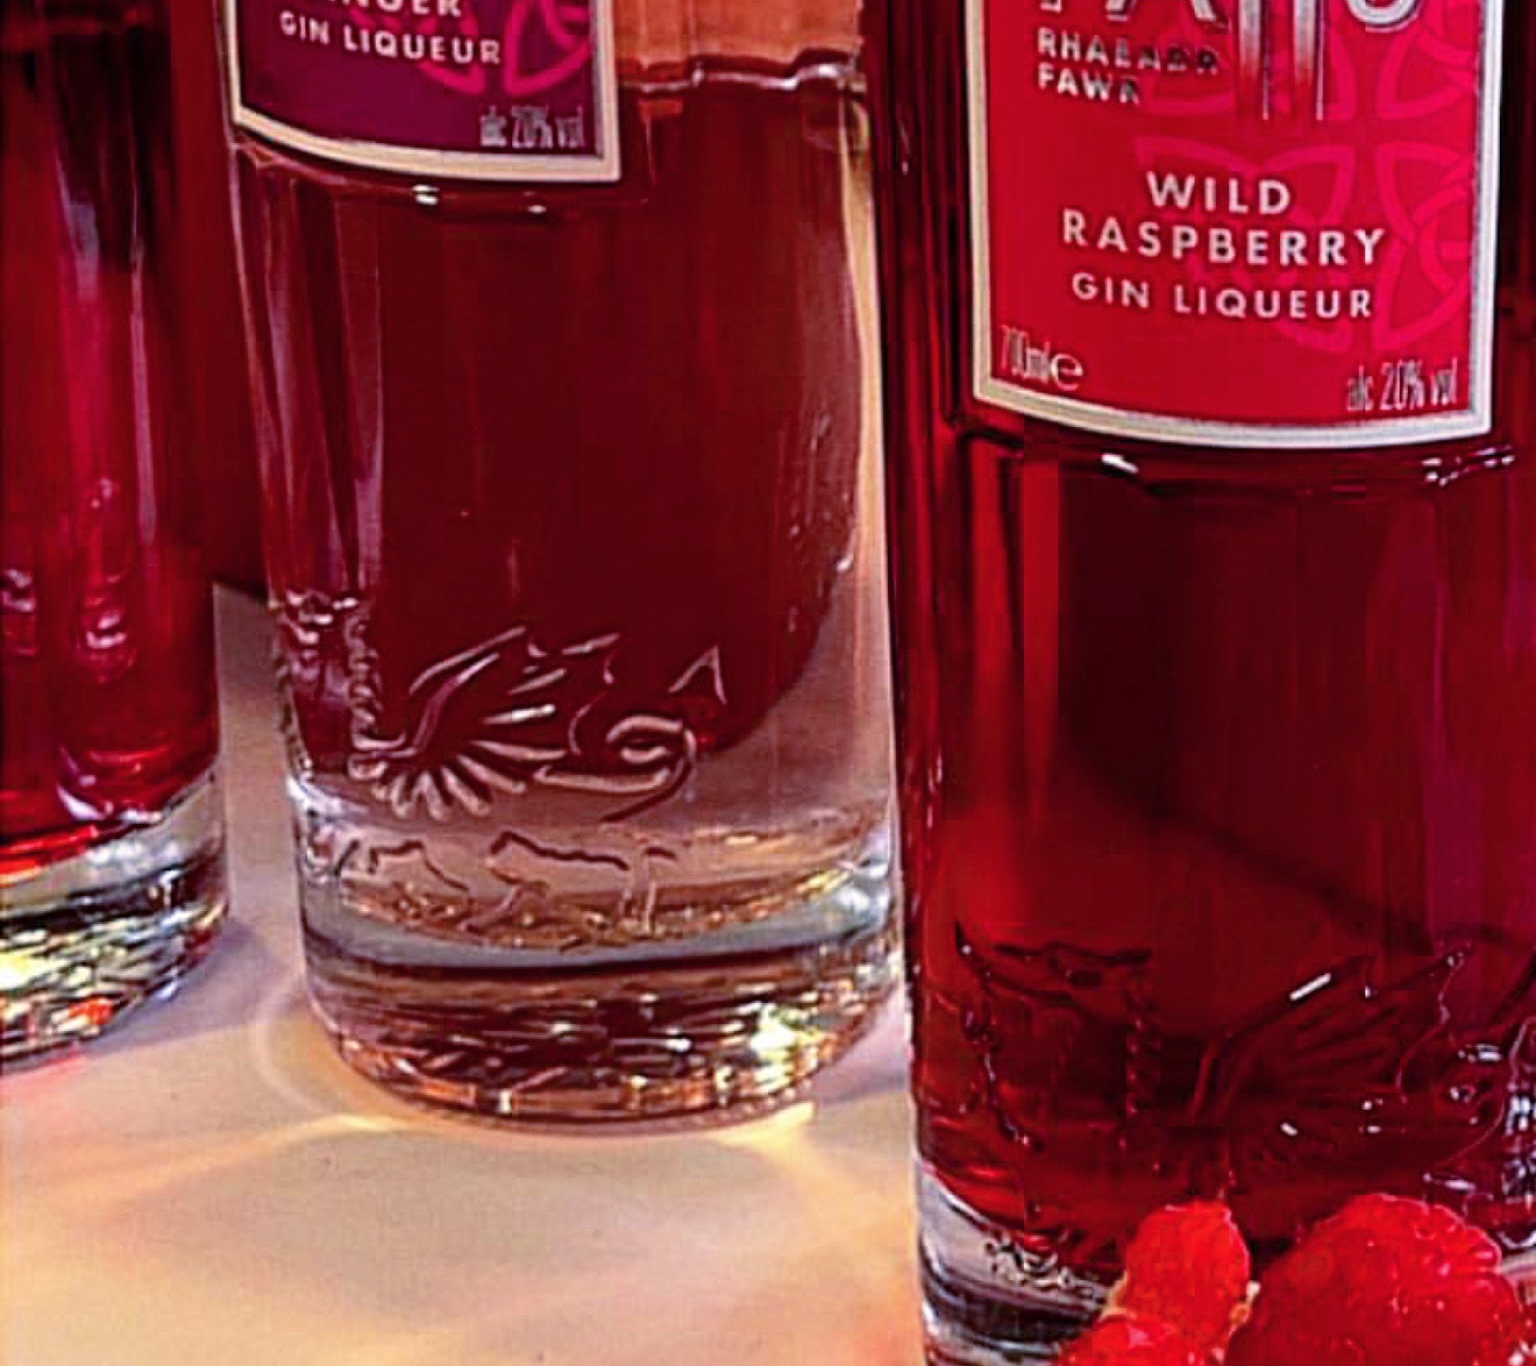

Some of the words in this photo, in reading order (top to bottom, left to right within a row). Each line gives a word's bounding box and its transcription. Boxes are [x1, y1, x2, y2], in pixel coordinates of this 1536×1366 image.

[279, 10, 330, 44] GIN
[343, 25, 501, 65] LIQUEUR
[1146, 171, 1292, 215] WILD
[1062, 208, 1386, 266] RASPBERRY
[1071, 272, 1150, 309] GIN
[1173, 285, 1372, 319] LIQUEUR
